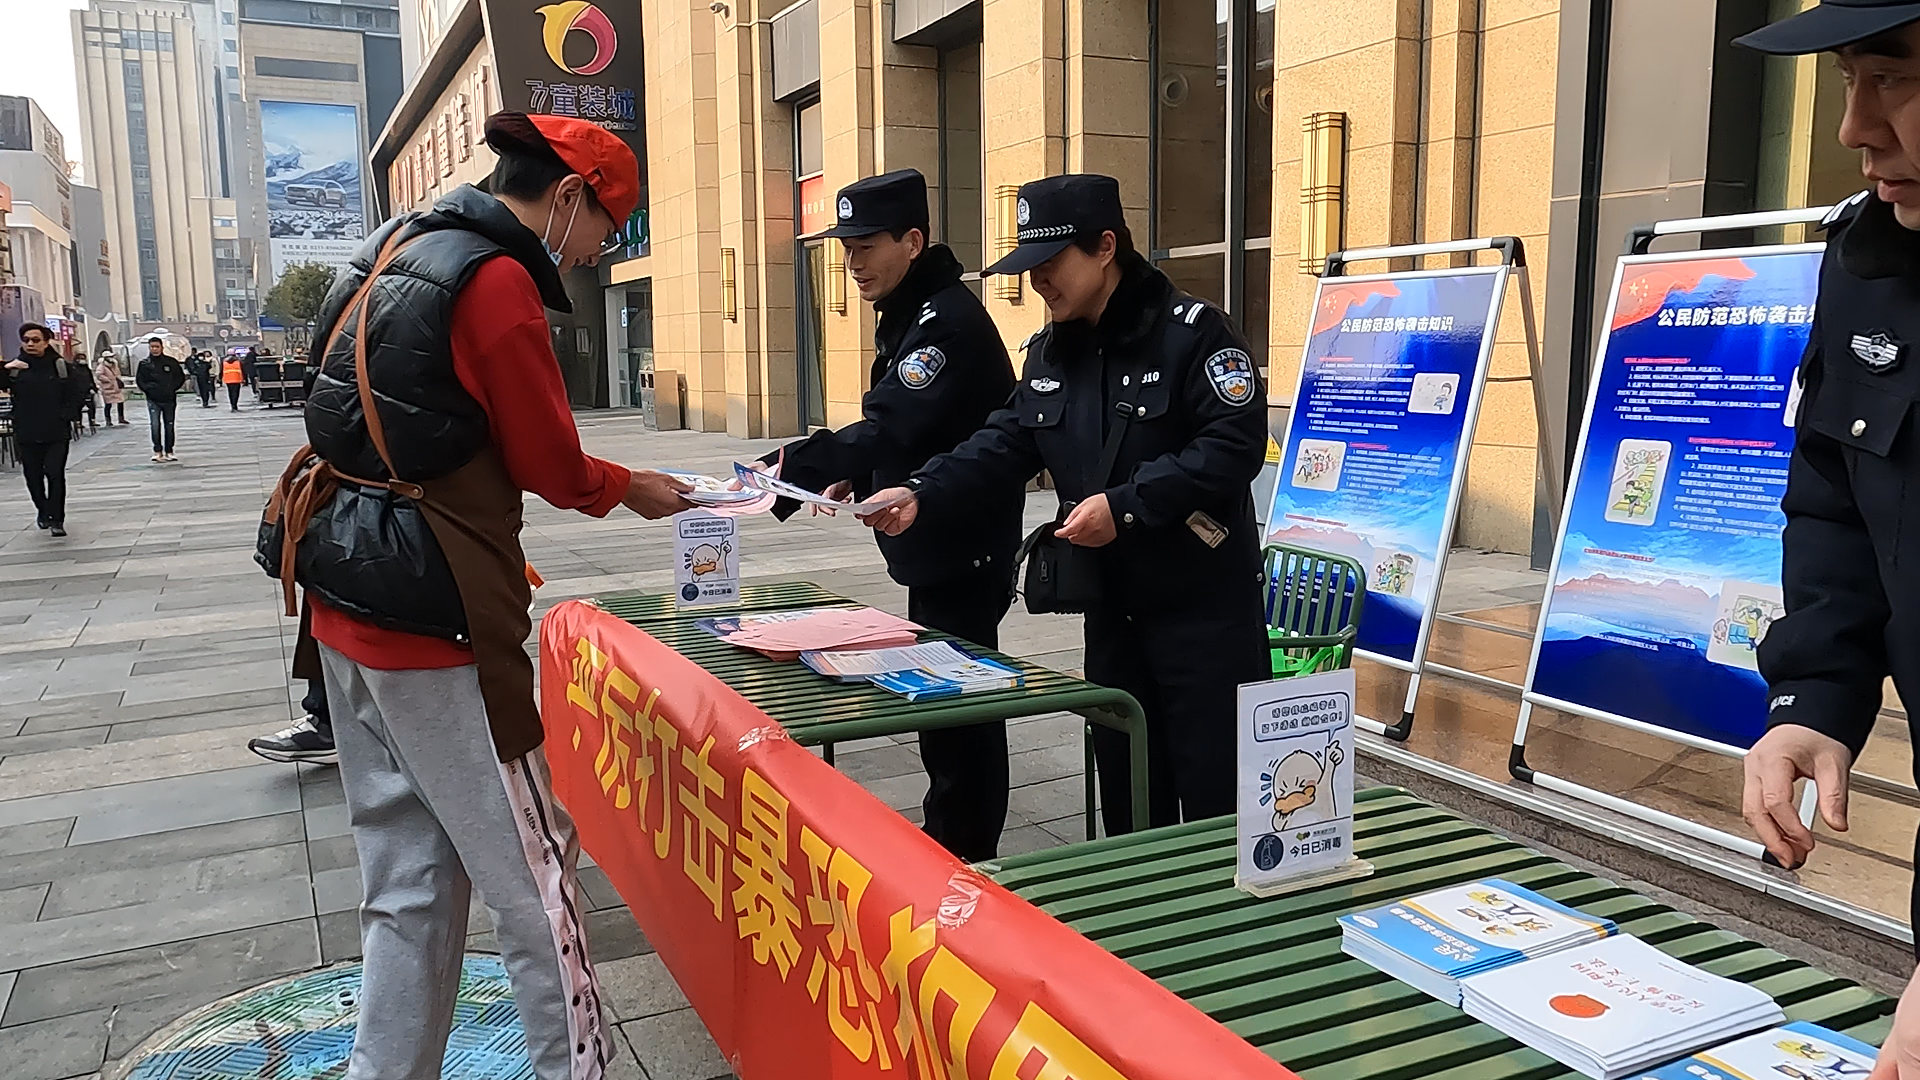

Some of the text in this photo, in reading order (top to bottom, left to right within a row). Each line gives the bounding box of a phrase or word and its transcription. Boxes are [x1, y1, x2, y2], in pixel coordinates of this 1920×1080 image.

[1340, 315, 1454, 333] 公民防范恐怖袭击知识
[566, 636, 1130, 1080] 严厉打击暴恐犯
[1289, 836, 1342, 858] 今日已消毒
[1570, 962, 1686, 1016] 中华人民共和国
